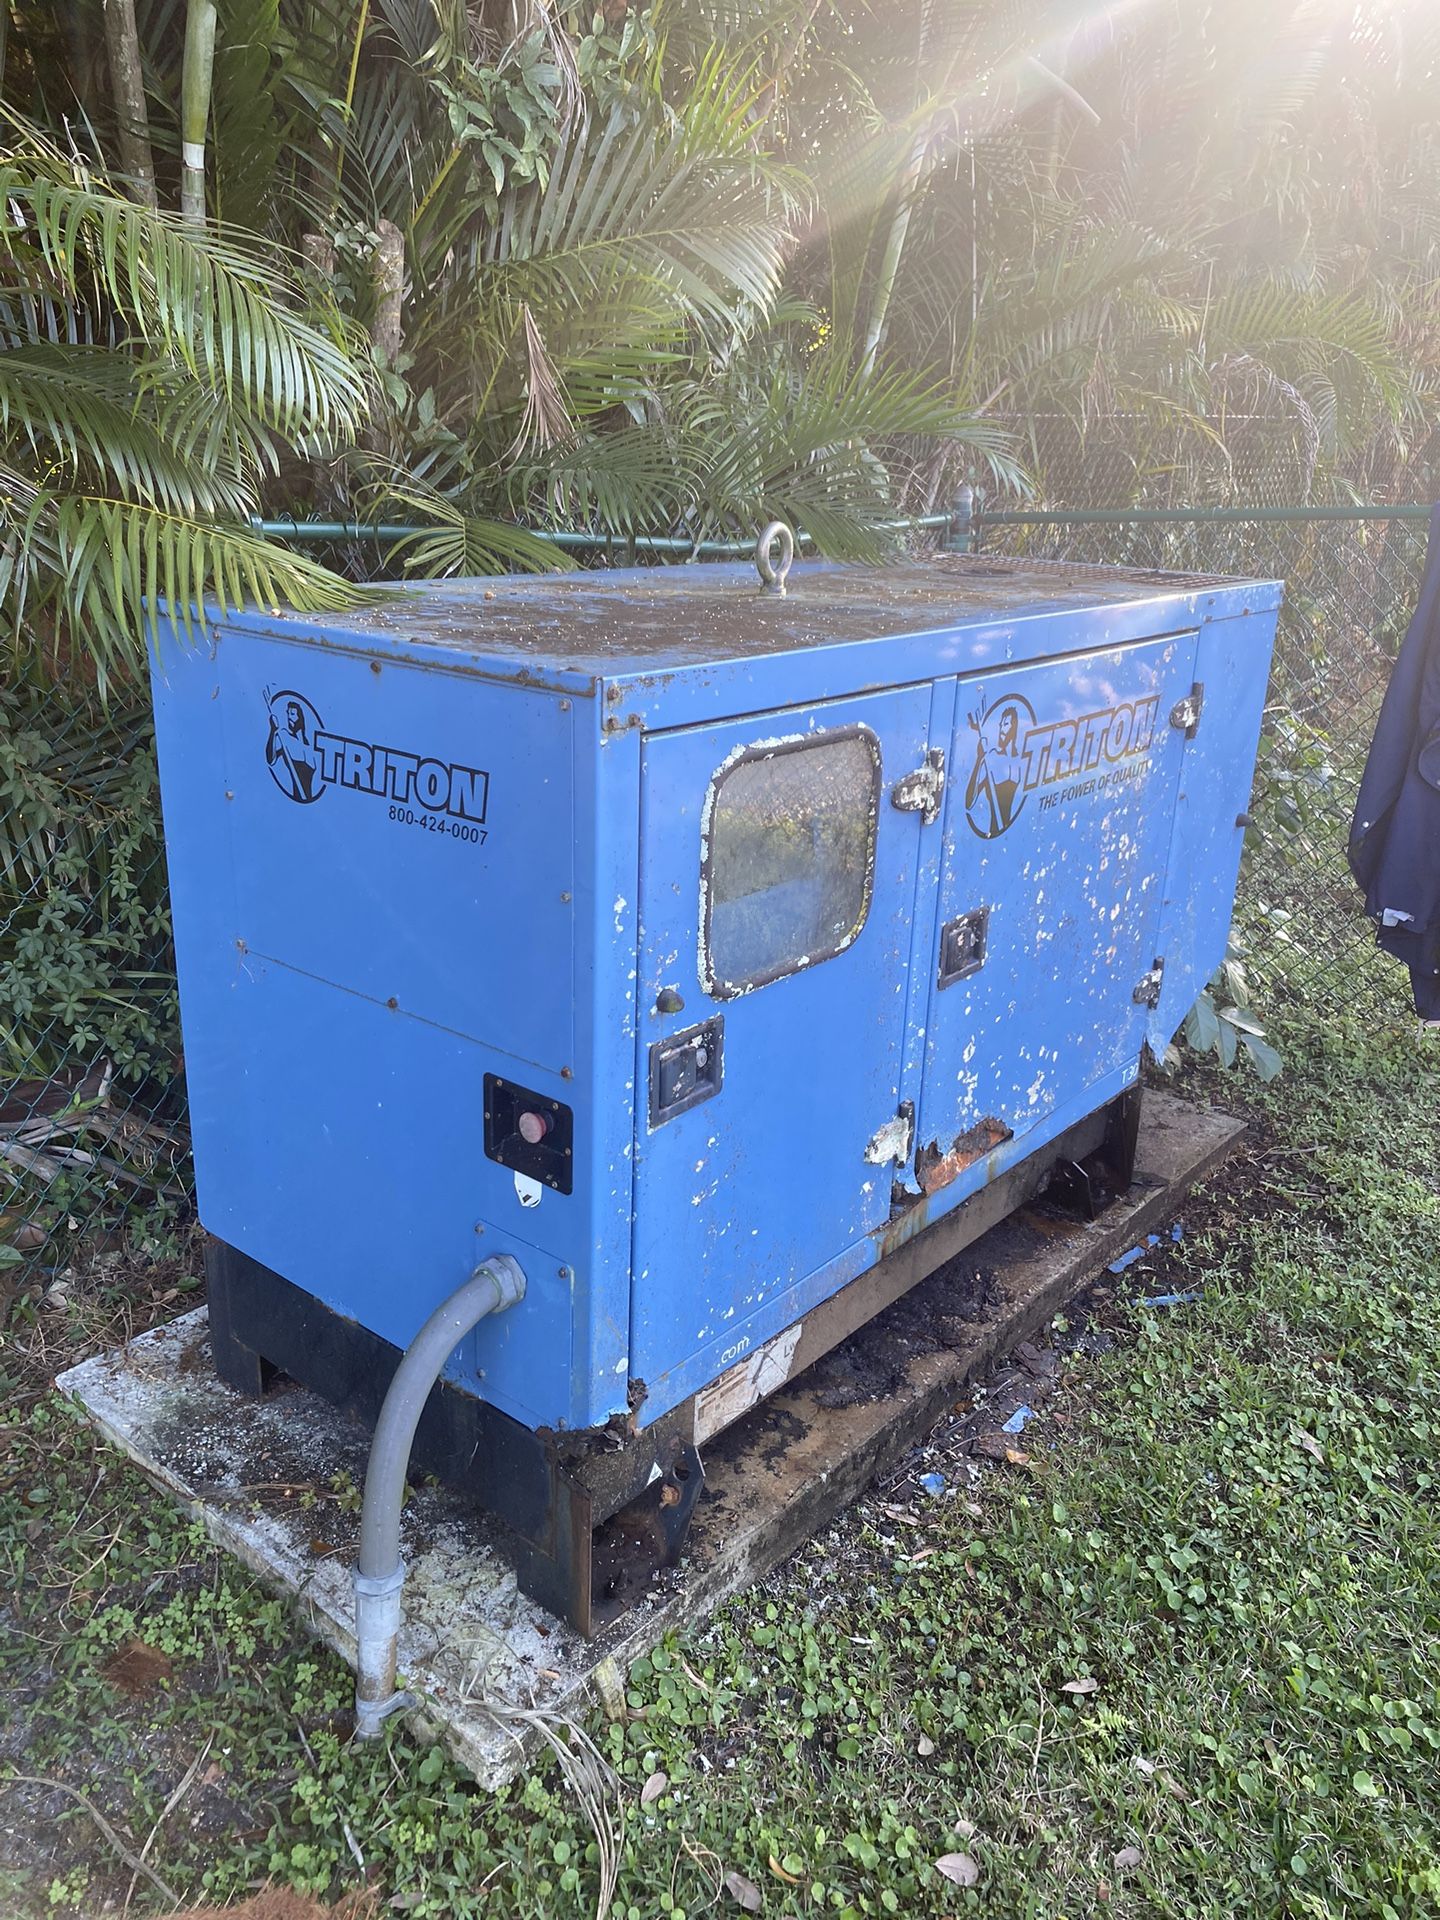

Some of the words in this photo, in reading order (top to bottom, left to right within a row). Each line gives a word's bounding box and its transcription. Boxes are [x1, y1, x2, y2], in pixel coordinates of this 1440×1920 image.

[1022, 695, 1160, 791] TRITON
[314, 731, 489, 824] TRITON
[1039, 791, 1060, 811] THE
[1060, 779, 1096, 804] POWER
[1098, 773, 1111, 790] OF
[388, 805, 488, 846] 800-424-0007
